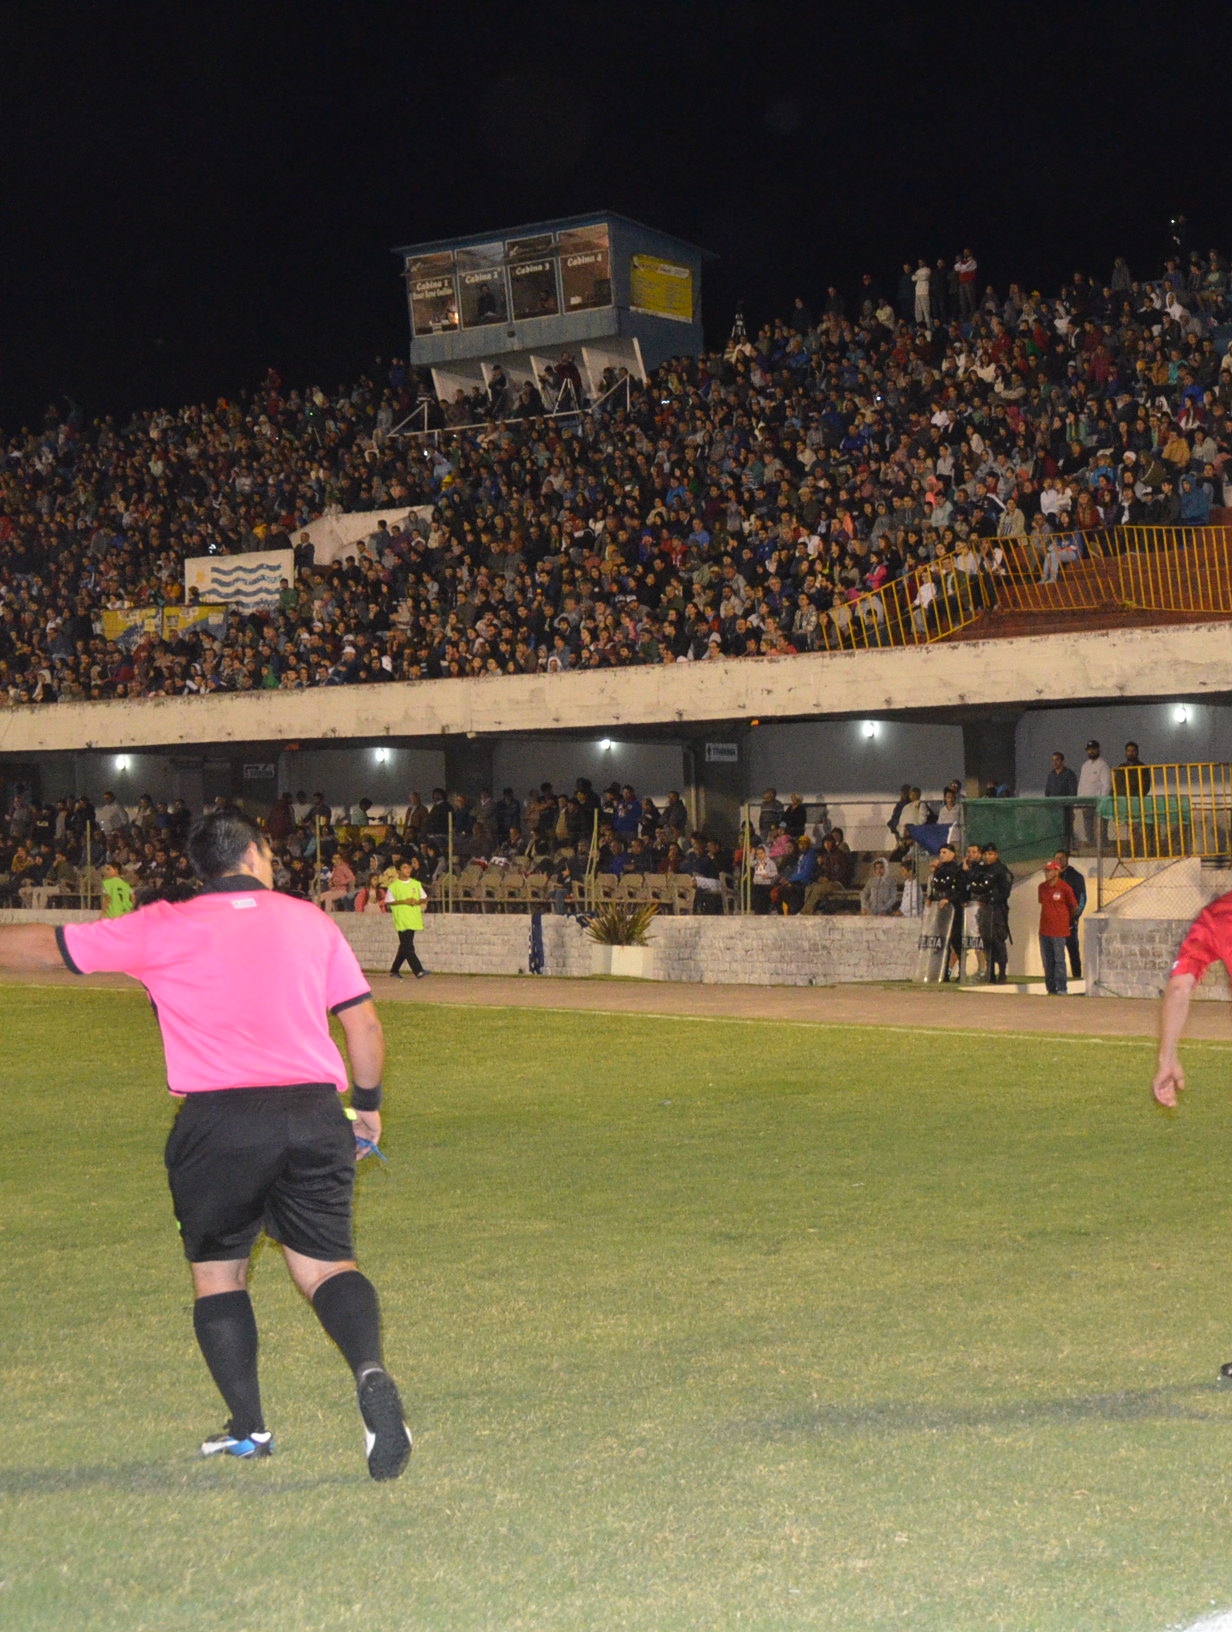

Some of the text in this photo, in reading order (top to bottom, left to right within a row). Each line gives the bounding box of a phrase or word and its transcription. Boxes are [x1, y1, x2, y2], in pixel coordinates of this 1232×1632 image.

[567, 254, 595, 267] Cabina
[515, 264, 543, 275] Cabina
[465, 273, 492, 285] Cabina
[416, 281, 442, 291] Cabina
